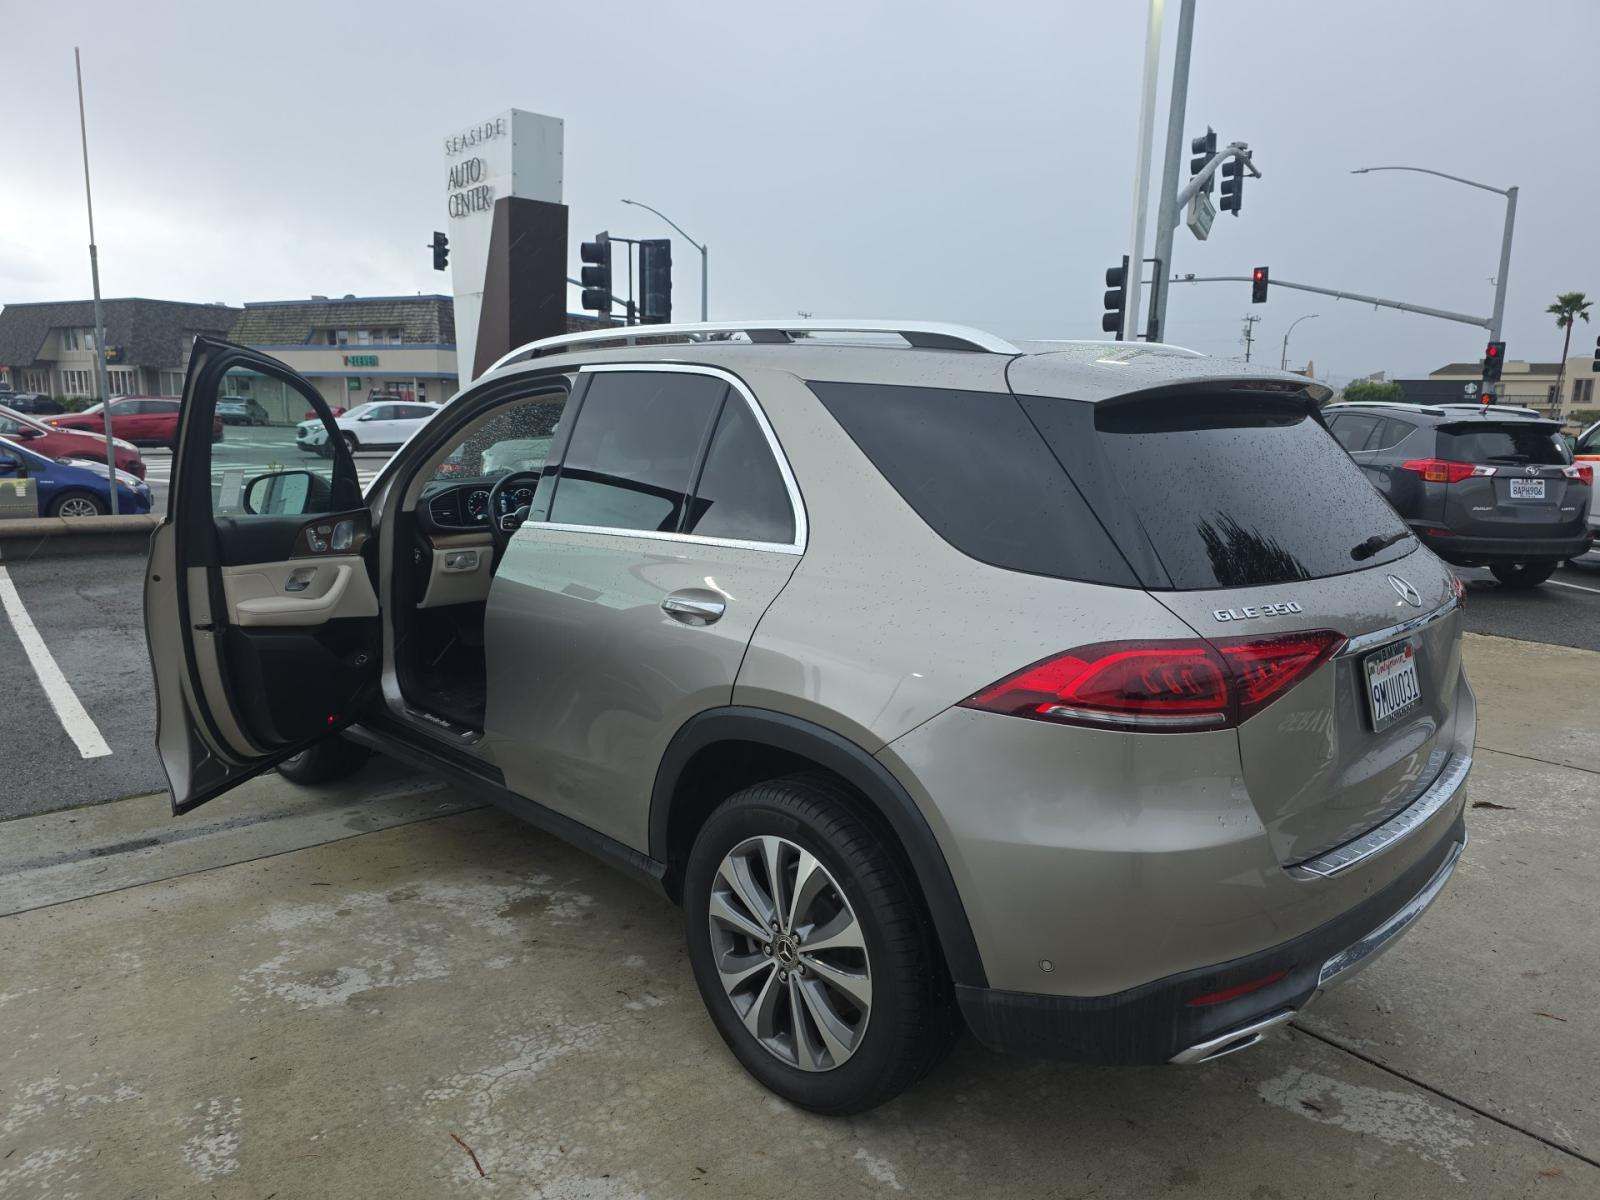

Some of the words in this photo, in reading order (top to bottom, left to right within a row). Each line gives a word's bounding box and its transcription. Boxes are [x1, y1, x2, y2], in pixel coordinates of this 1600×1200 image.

[445, 118, 506, 155] SEASIDE
[448, 157, 481, 190] AUTO
[449, 184, 491, 218] CENTER
[1213, 607, 1260, 622] GLE
[1260, 601, 1303, 617] 350
[1373, 667, 1419, 719] 9MUU031
